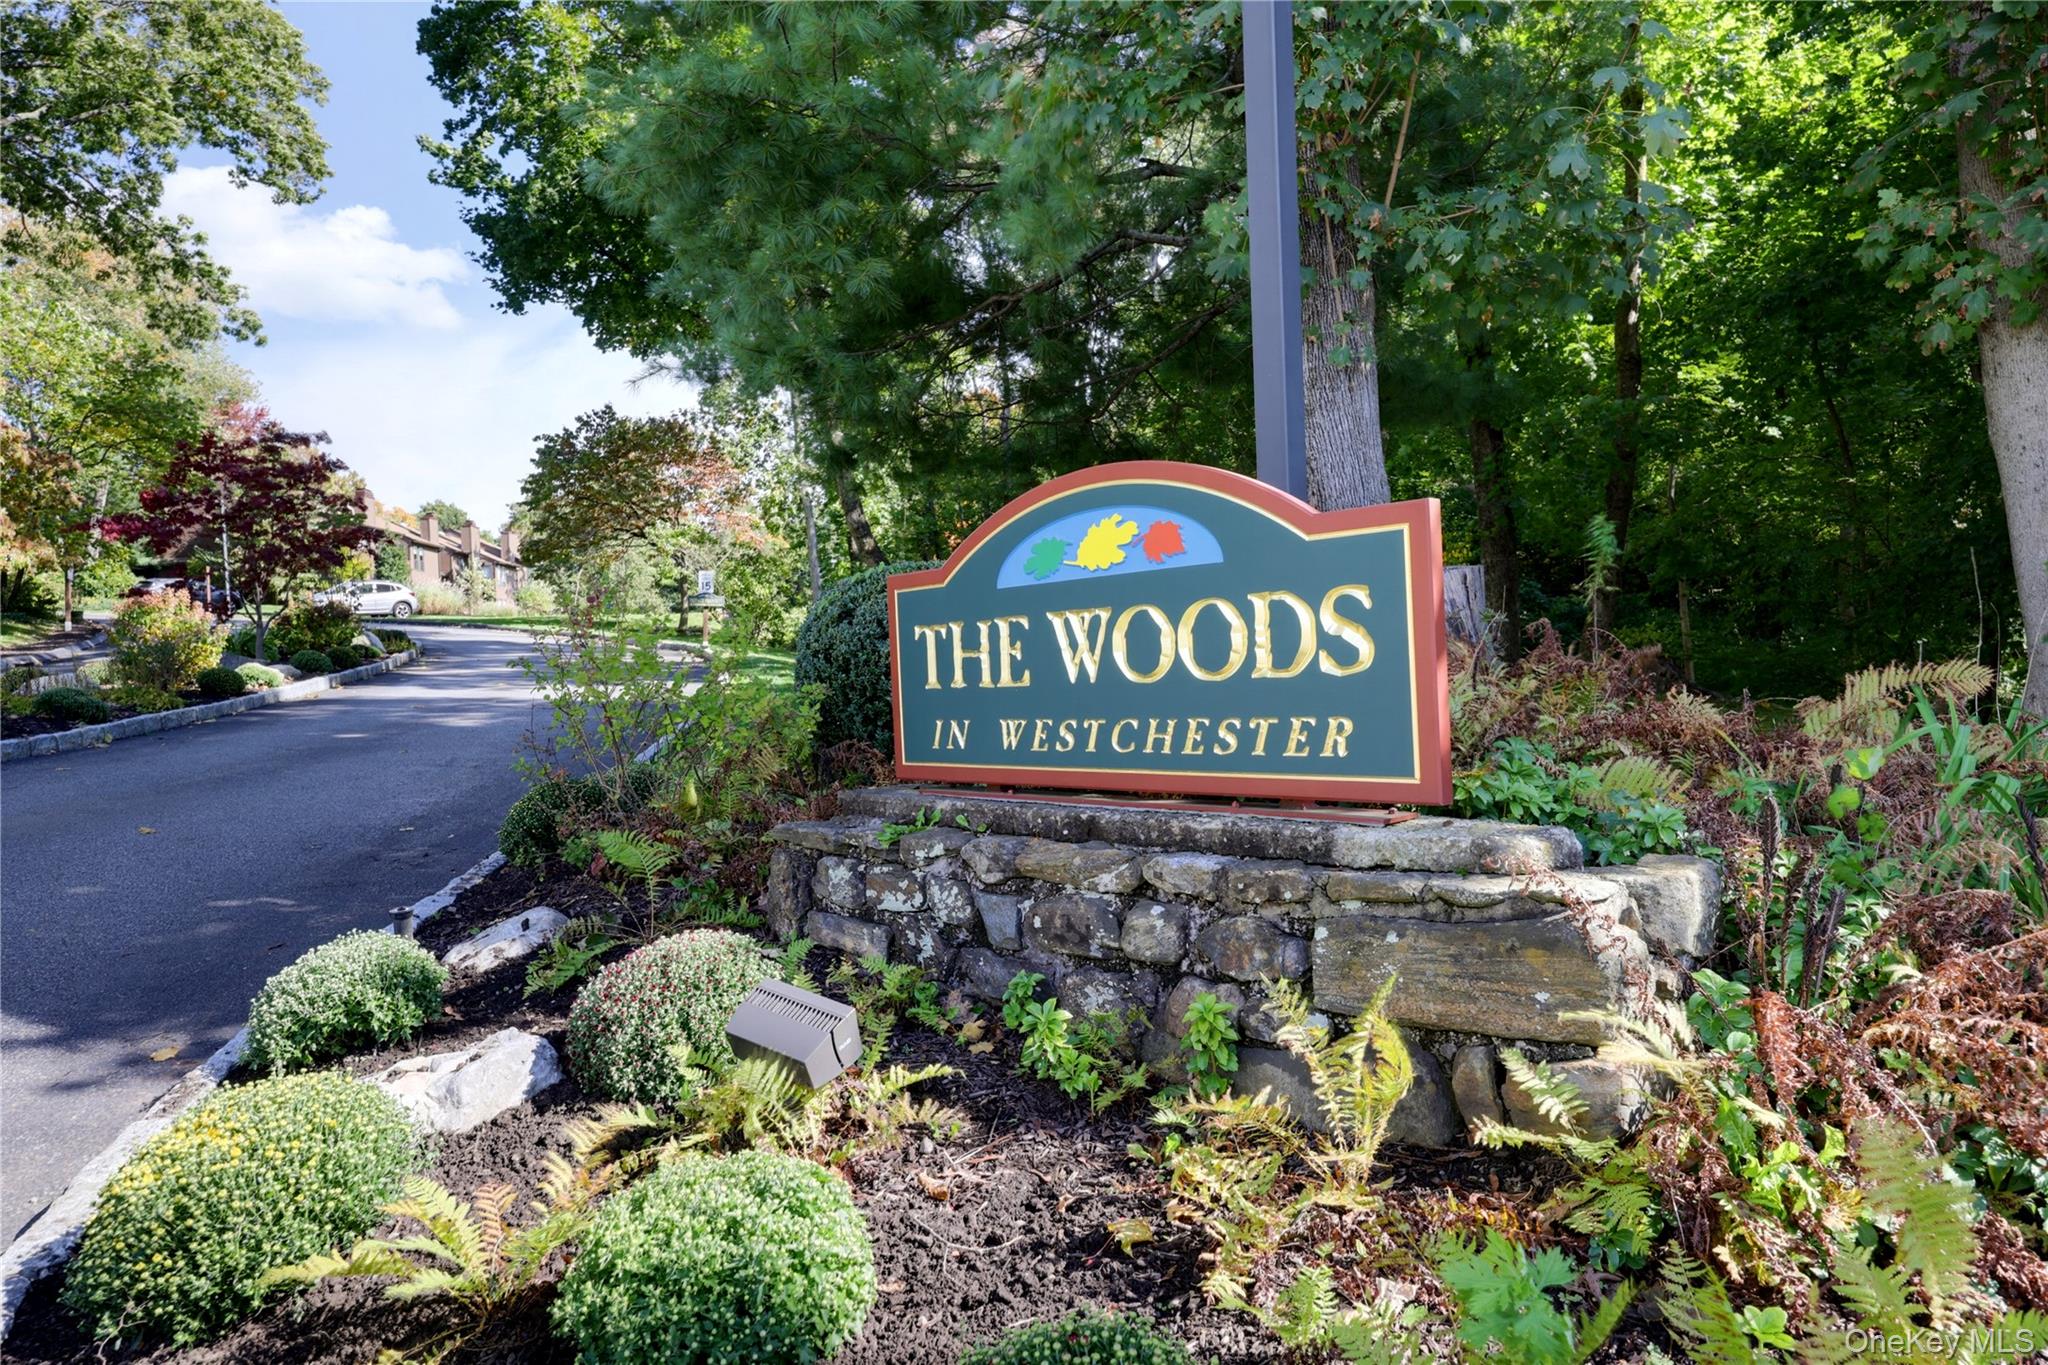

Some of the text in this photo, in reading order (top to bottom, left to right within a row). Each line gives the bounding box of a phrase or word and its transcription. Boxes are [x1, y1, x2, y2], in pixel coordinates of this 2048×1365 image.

[701, 581, 712, 591] 15
[914, 584, 1375, 690] THE WOODS
[932, 716, 1355, 758] IN WESTCHESTER
